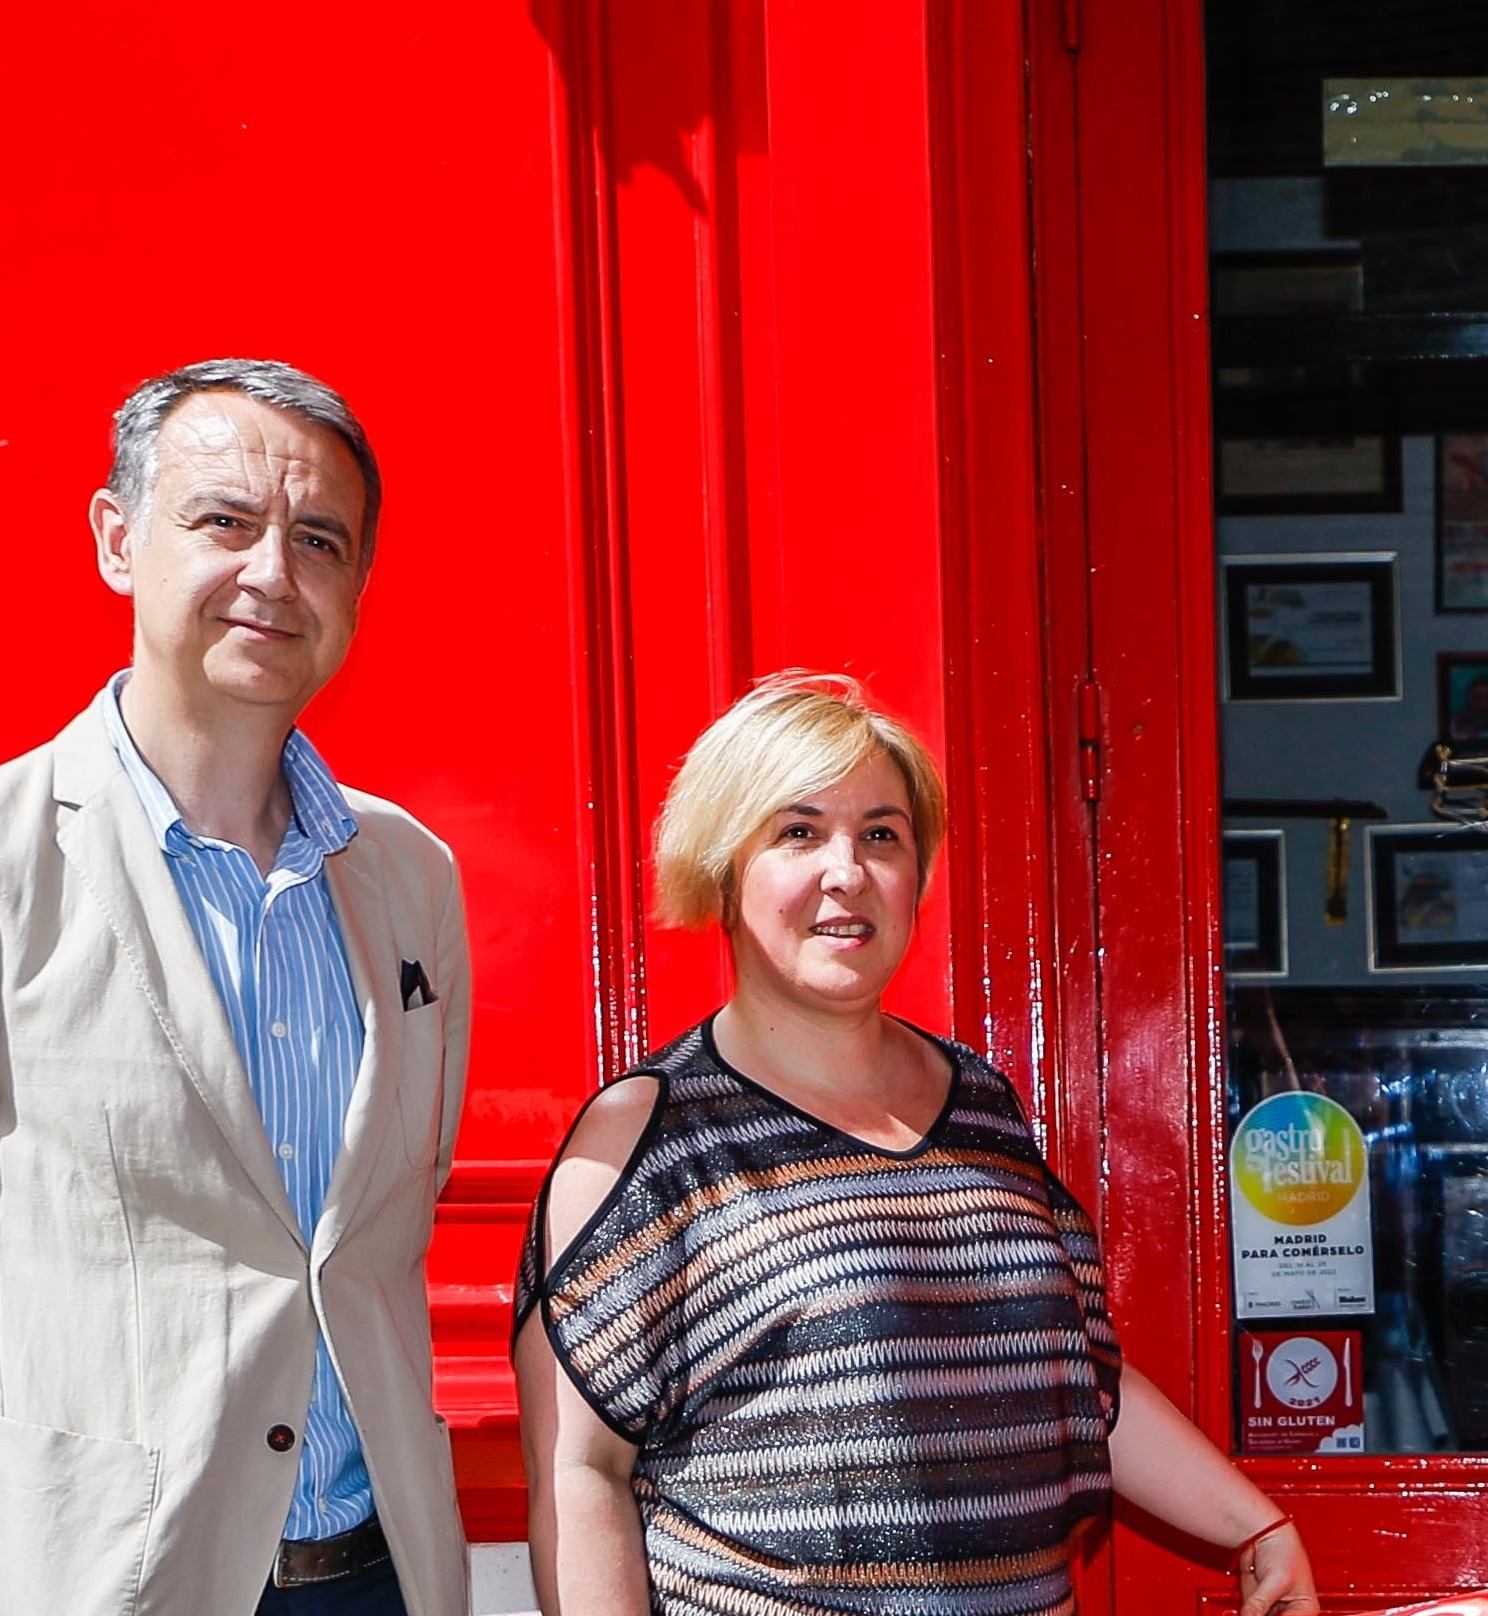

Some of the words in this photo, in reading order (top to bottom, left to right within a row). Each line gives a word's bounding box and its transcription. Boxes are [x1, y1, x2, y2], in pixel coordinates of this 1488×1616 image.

[1244, 1122, 1323, 1173] gastro
[1261, 1128, 1353, 1194] festival
[1277, 1190, 1330, 1201] MADRID
[1274, 1234, 1327, 1245] MADRID
[1242, 1248, 1278, 1259] PARA
[1283, 1245, 1364, 1258] COMÉRSELO
[1248, 1416, 1272, 1427] SIN
[1277, 1415, 1336, 1426] GLUTEN
